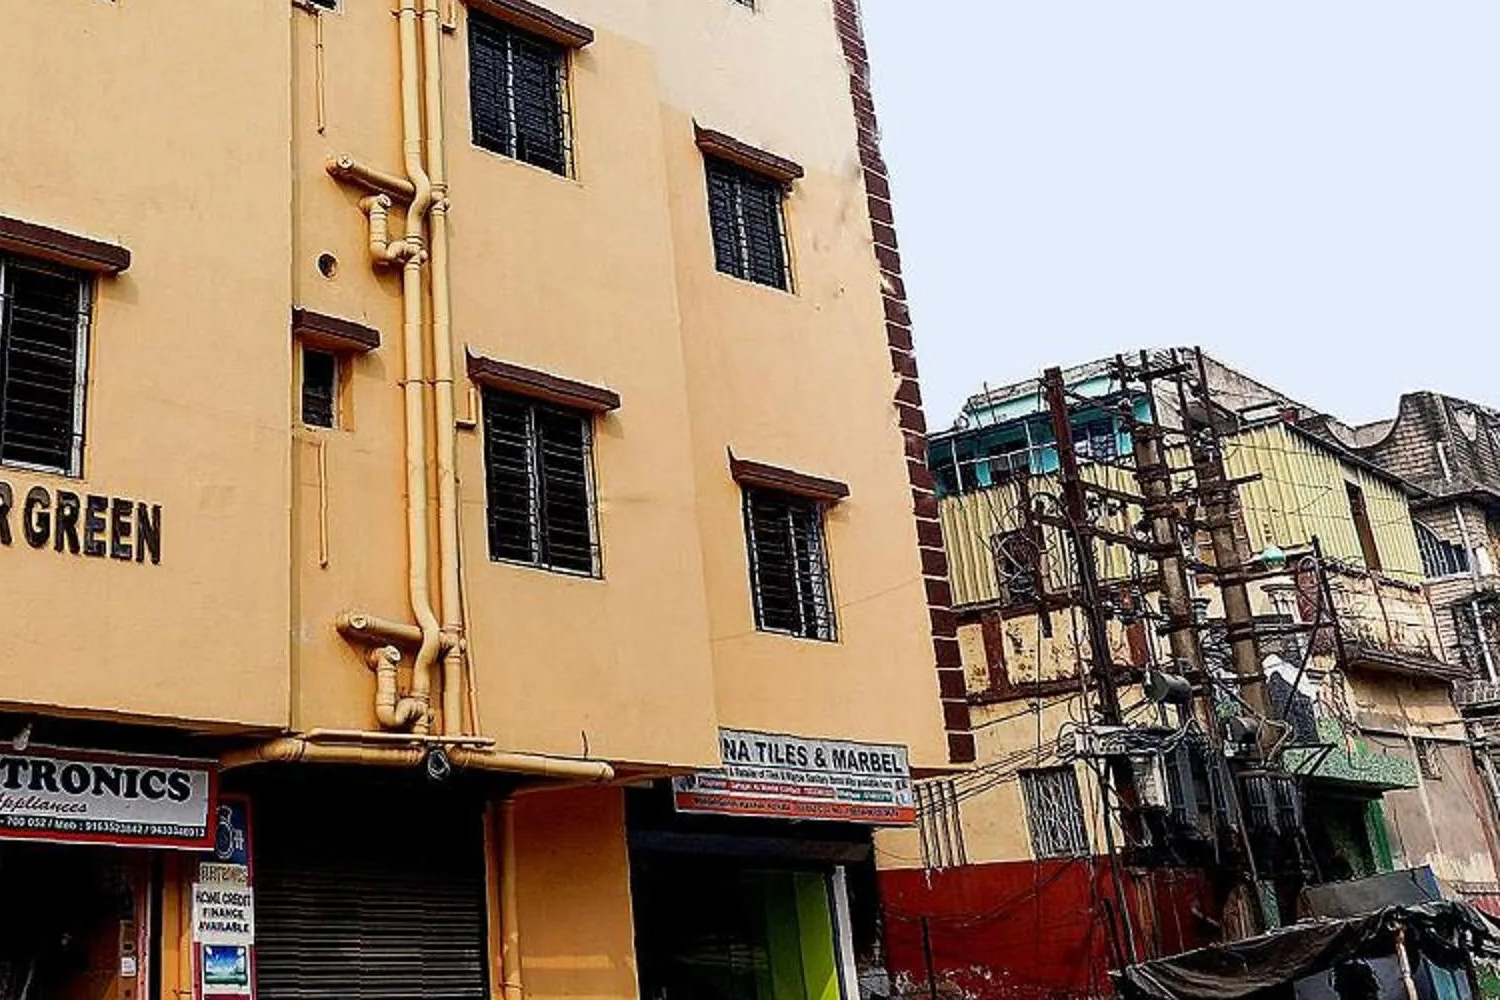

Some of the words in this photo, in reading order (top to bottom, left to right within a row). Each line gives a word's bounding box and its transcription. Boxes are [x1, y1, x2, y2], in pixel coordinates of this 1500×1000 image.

[23, 486, 162, 566] GREEN
[755, 741, 808, 767] TILES
[814, 747, 827, 768] &
[832, 749, 903, 773] MARBEL
[7, 816, 26, 827] 700
